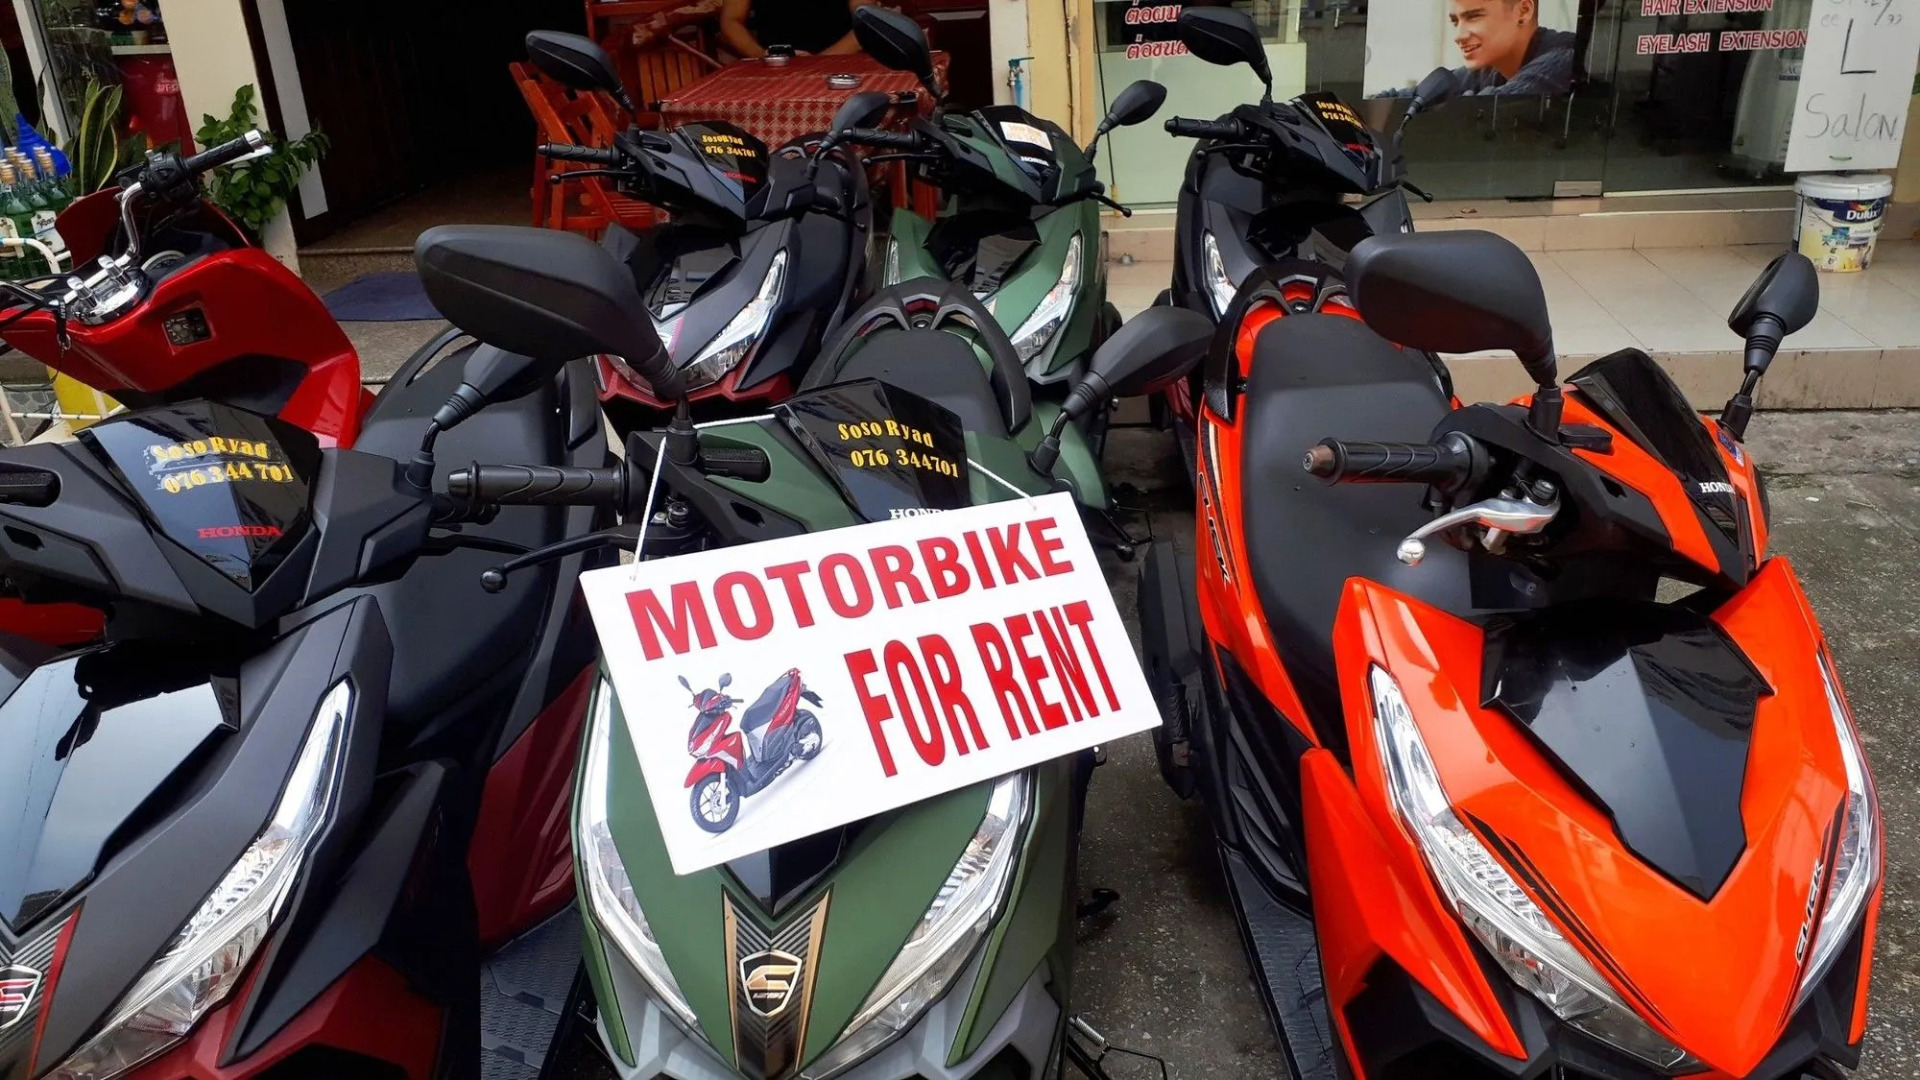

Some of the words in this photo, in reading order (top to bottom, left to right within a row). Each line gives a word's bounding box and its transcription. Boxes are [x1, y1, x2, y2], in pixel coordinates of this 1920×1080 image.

[1641, 0, 1680, 16] HAIR
[1683, 0, 1773, 14] EXTENSION
[1637, 33, 1711, 54] EYELASH
[705, 146, 724, 154] 076
[1846, 210, 1877, 221] Dulux
[838, 422, 883, 441] Soso
[884, 419, 934, 448] Ryad
[150, 440, 208, 462] Soso
[208, 436, 269, 459] Ryad
[850, 449, 889, 468] 076
[896, 448, 959, 478] 344701
[163, 468, 208, 494] 076
[198, 525, 284, 539] HONDA
[625, 517, 1075, 661] MOTORBIKE
[843, 633, 990, 778] FOR
[969, 600, 1122, 742] RENT
